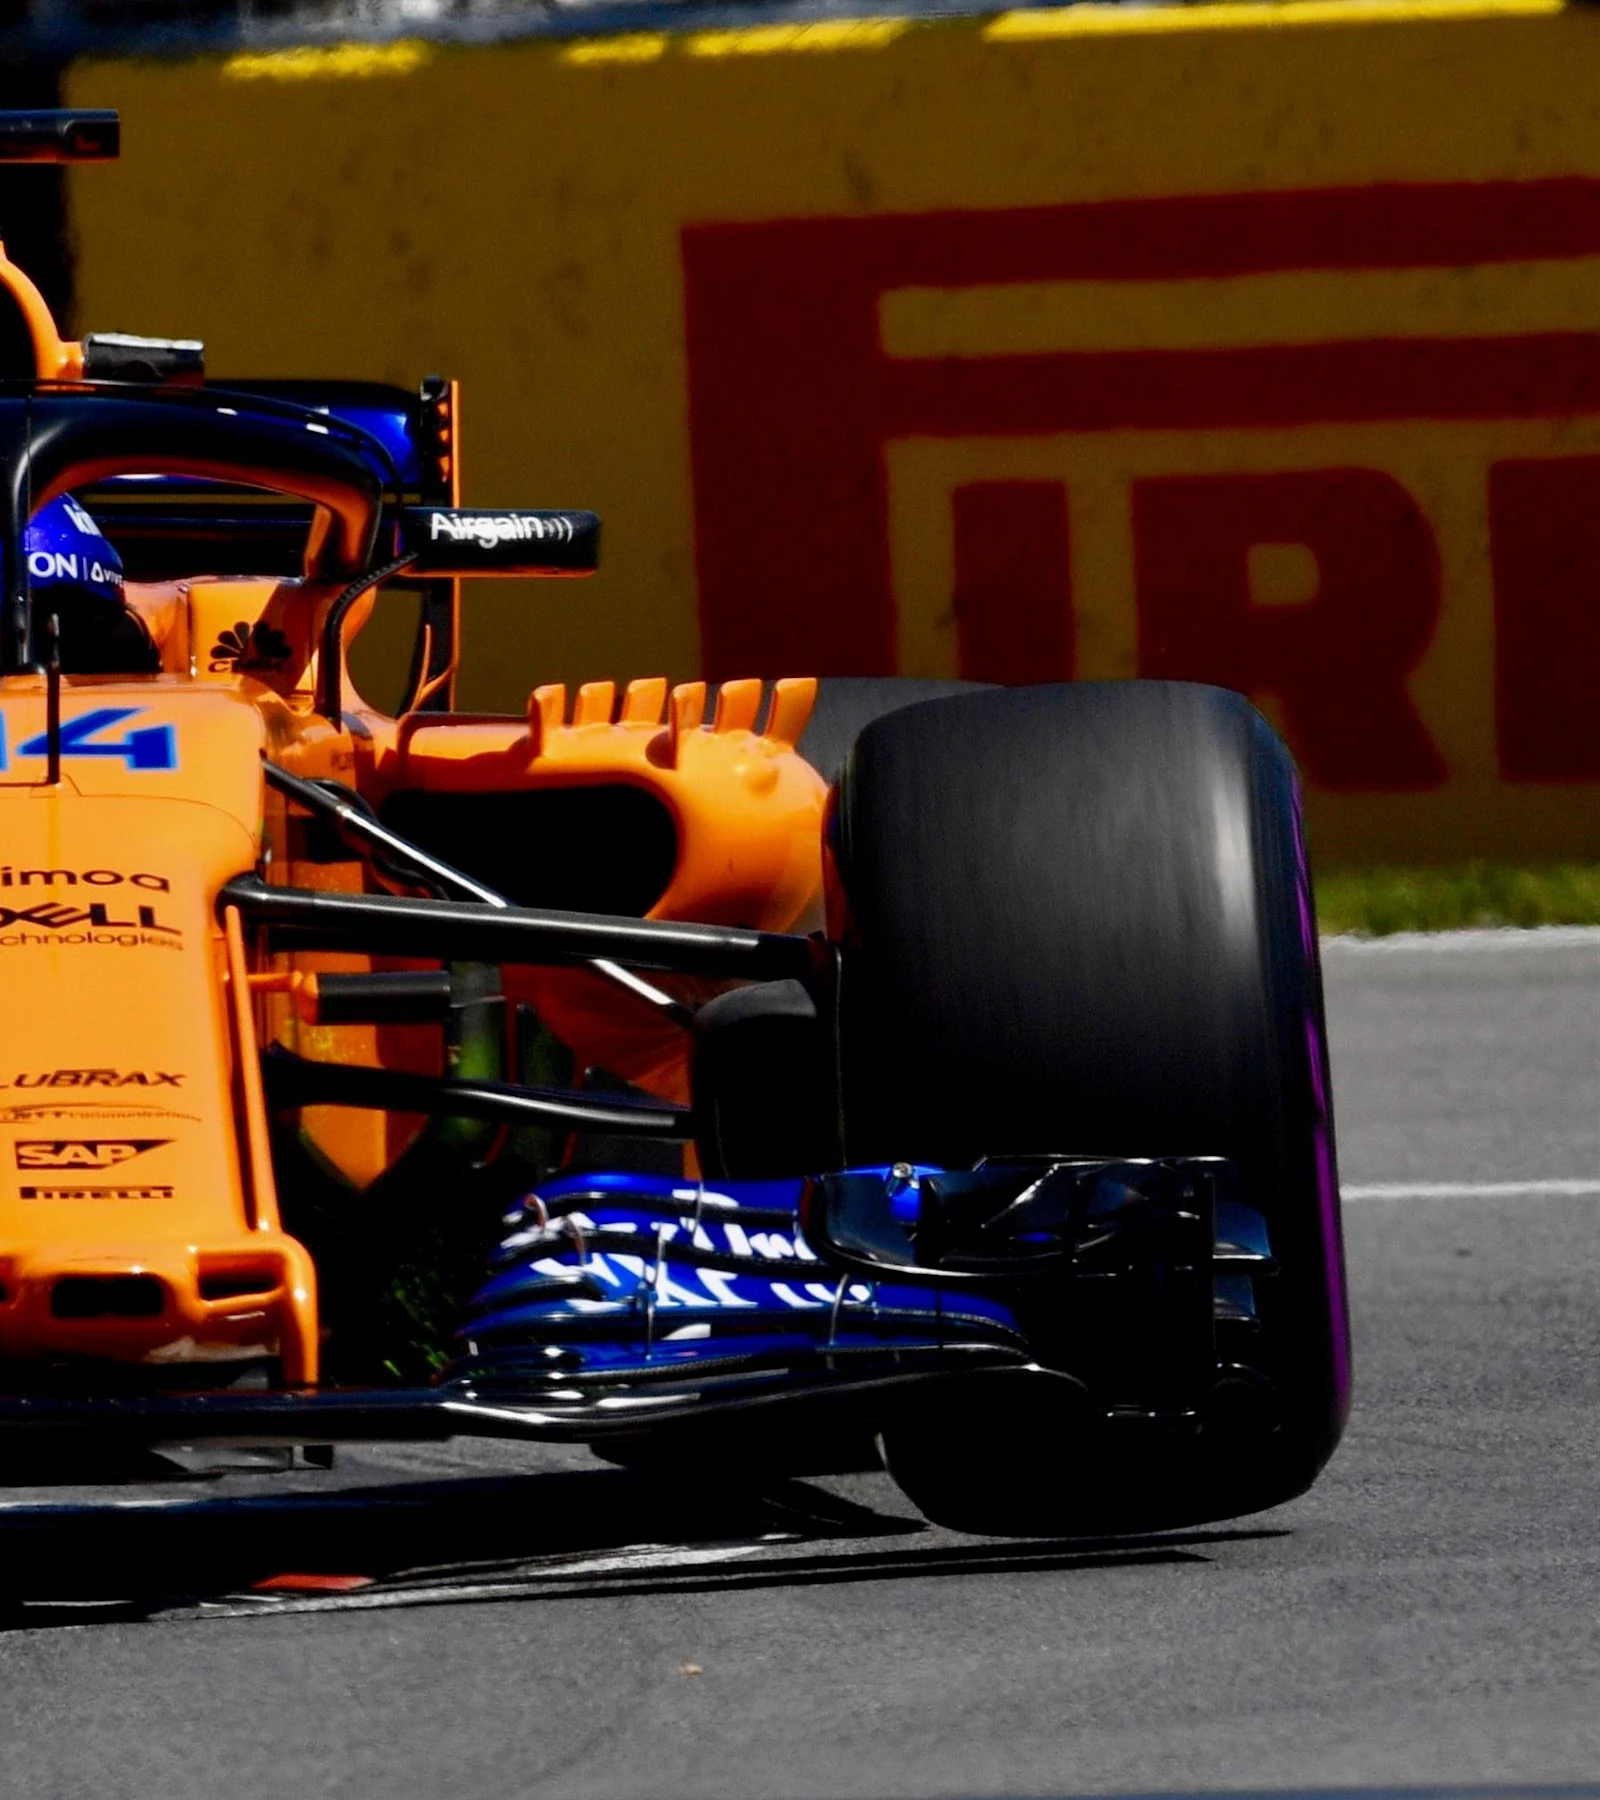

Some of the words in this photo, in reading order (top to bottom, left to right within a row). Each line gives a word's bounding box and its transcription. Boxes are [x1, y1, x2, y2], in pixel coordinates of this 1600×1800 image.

[430, 513, 545, 549] Airgain
[18, 1143, 138, 1166] SAP
[19, 1186, 175, 1200] PIRELLI
